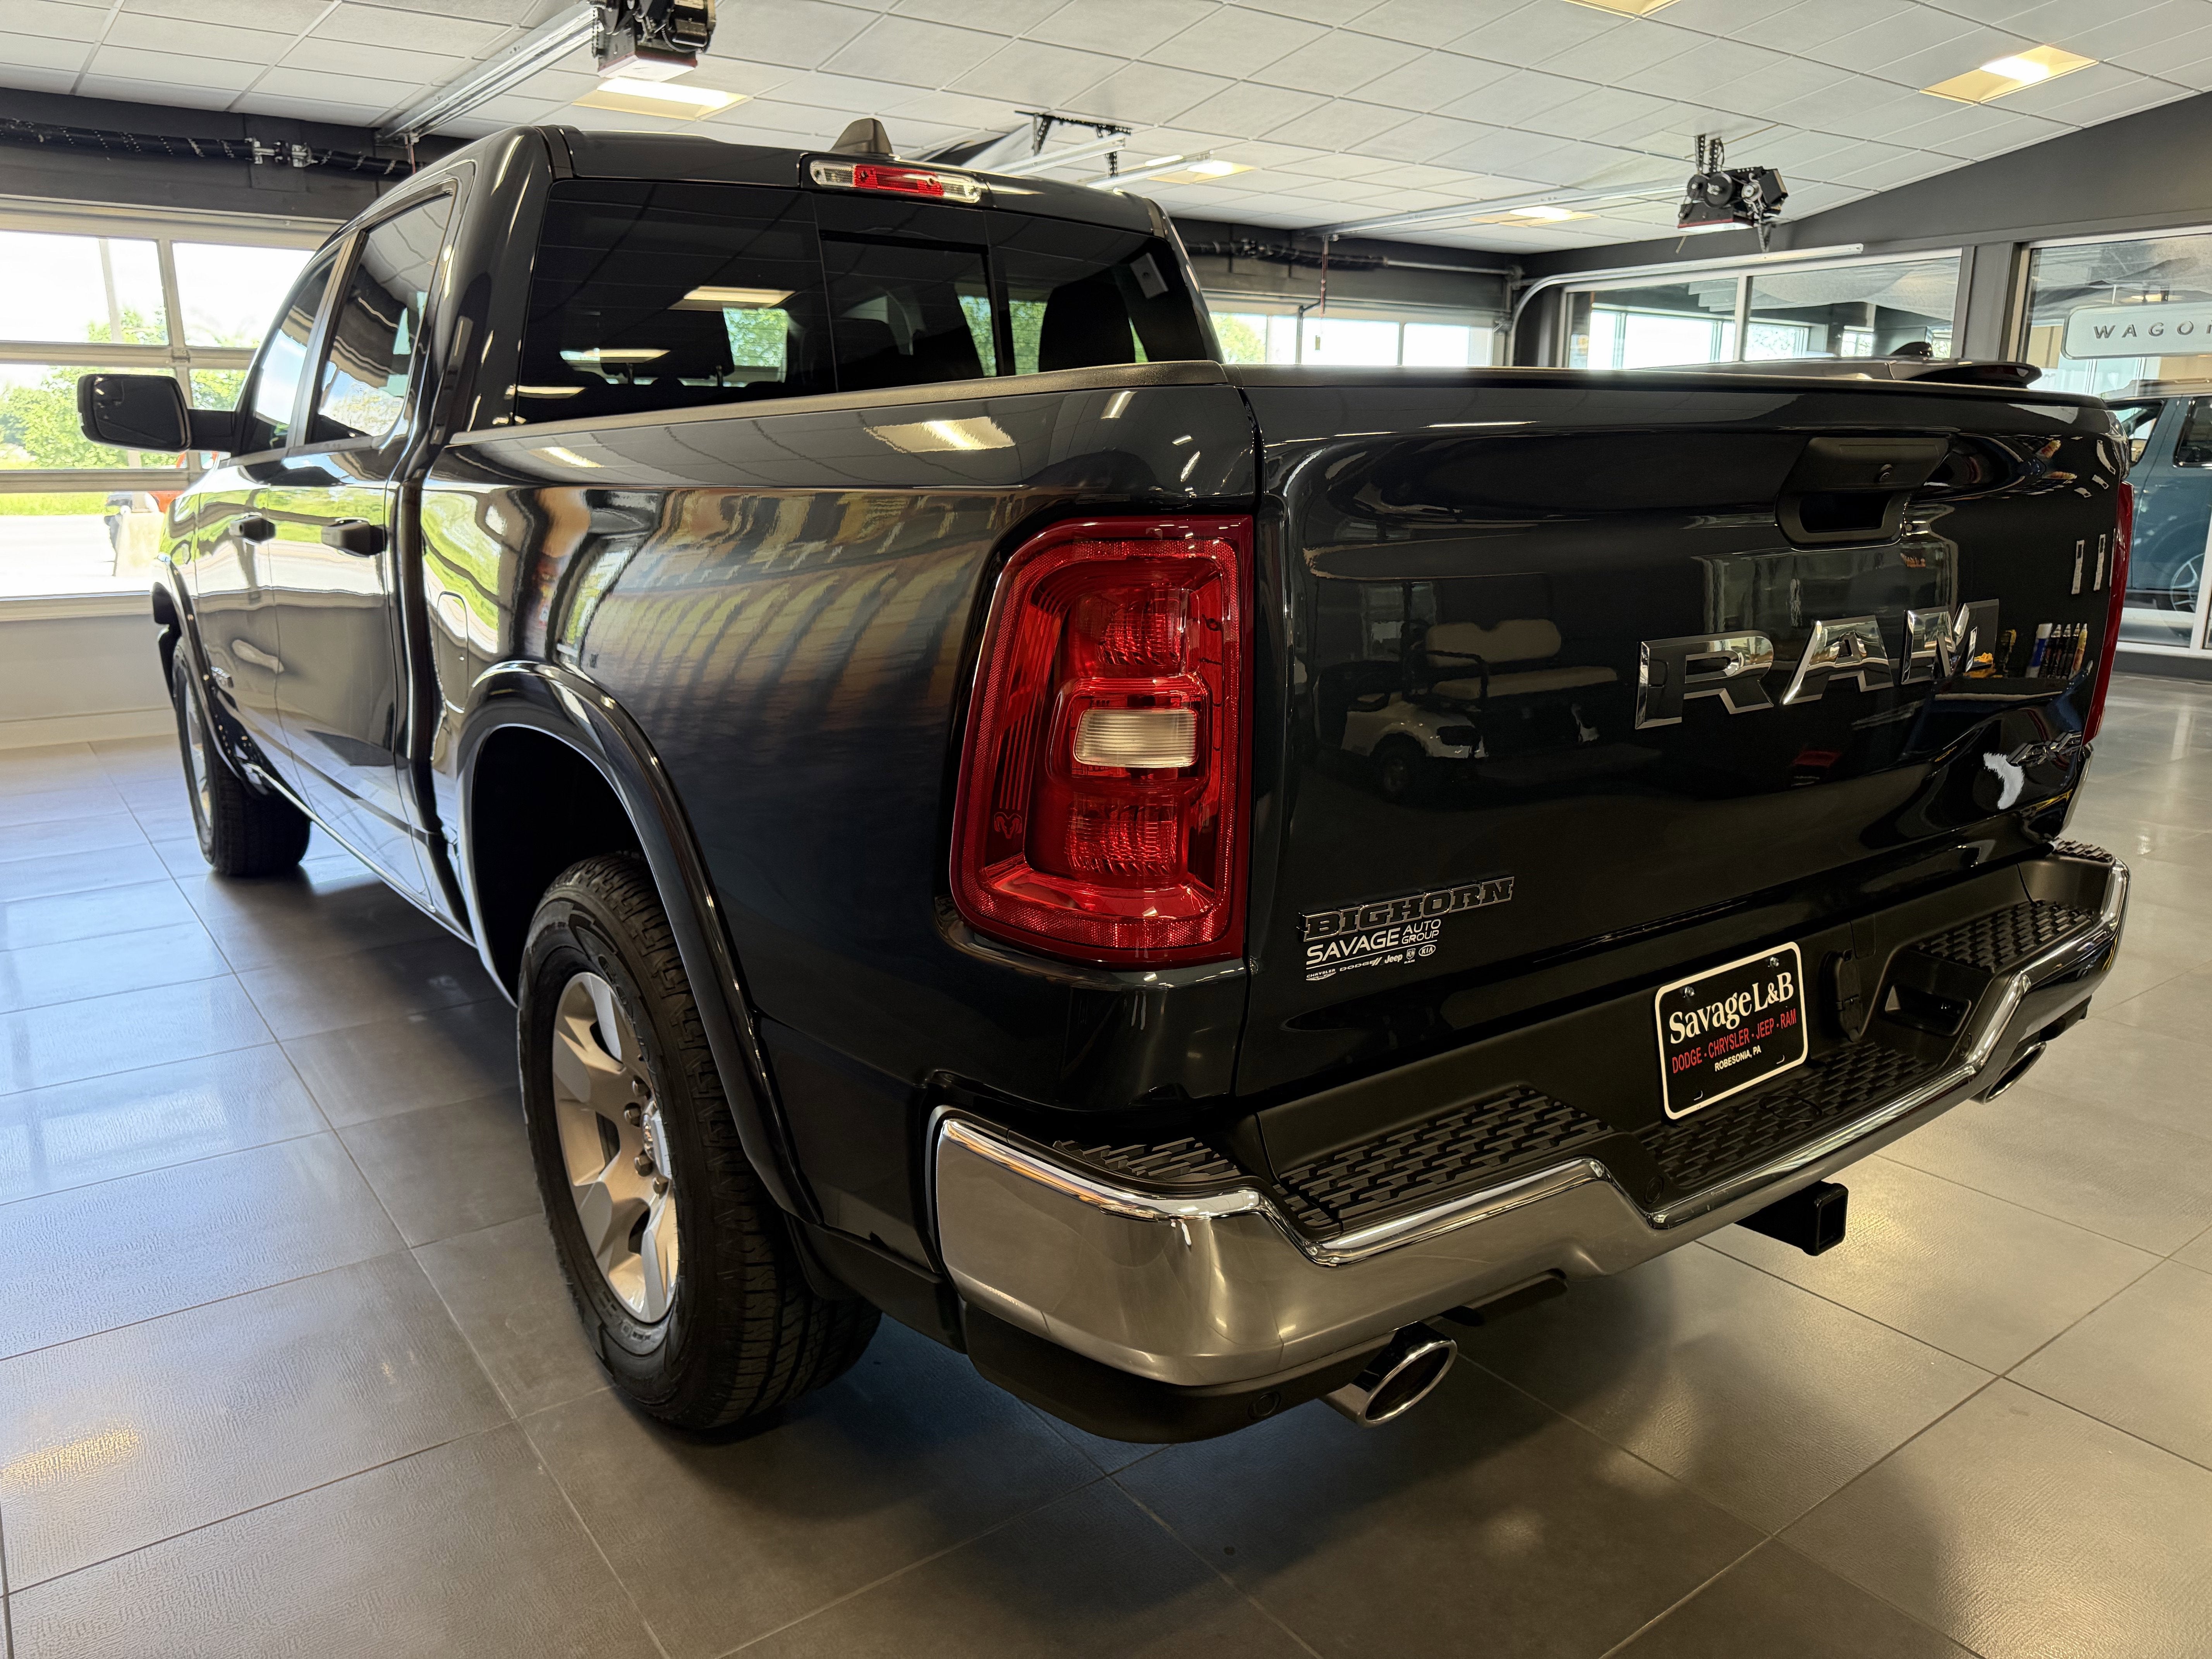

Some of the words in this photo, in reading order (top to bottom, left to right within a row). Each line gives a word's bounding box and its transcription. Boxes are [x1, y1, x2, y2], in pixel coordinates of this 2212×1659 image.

[1633, 598, 1999, 730] RAM
[1401, 930, 1439, 945] GROUP
[1403, 919, 1441, 934] AUTO
[1306, 927, 1401, 965] SAVAGE
[1306, 968, 1336, 979] CHRYSLER
[1340, 960, 1376, 972] DODGE
[1384, 953, 1403, 964] Jeep
[1672, 1047, 1703, 1074] DODGE
[1708, 1028, 1750, 1059] CHRYSLER
[1756, 1018, 1774, 1040] JEEP
[1780, 1008, 1797, 1029] RAM
[1714, 1049, 1752, 1072] ROBESONIA,
[1753, 1045, 1762, 1055] PA
